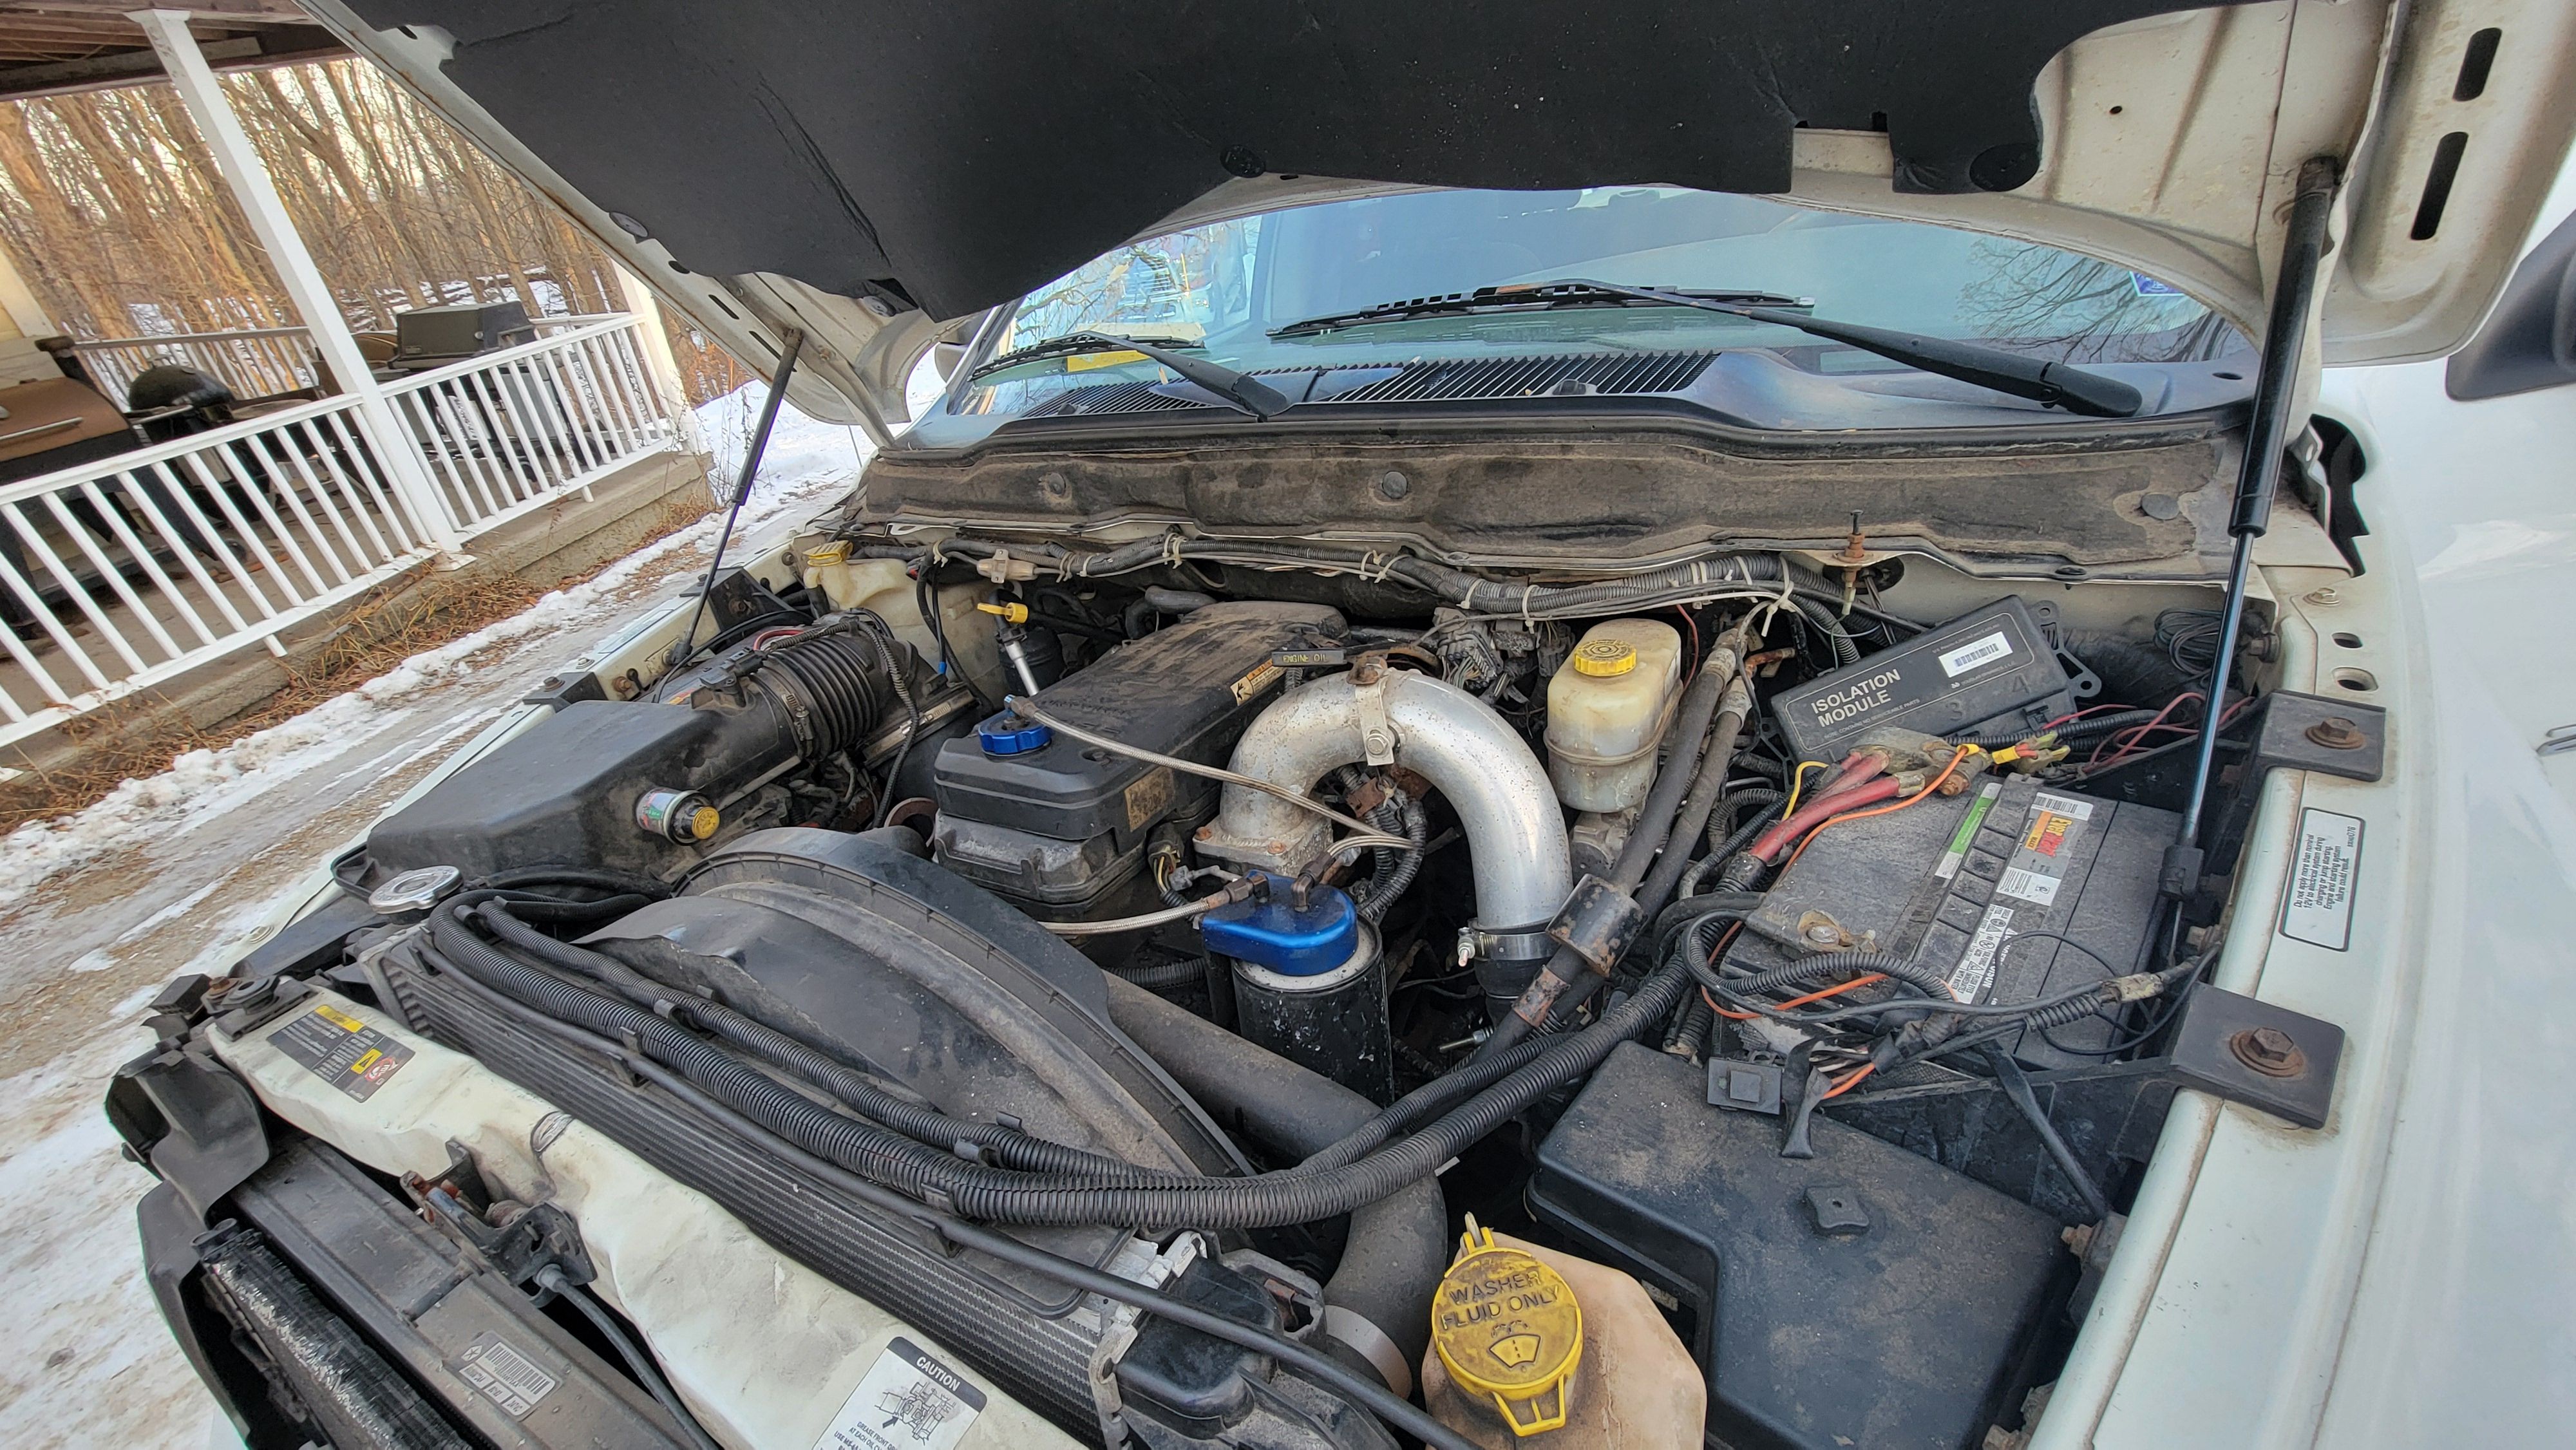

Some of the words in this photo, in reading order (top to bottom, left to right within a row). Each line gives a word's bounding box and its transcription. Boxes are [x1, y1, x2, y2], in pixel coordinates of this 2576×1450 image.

[1283, 655, 1309, 663] ENGINE
[1811, 669, 1902, 714] ISOLATION
[1818, 690, 1891, 728] MODULE
[1903, 698, 1920, 708] PARTS
[2027, 836, 2038, 848] MAXX
[2315, 837, 2325, 851] during
[2313, 852, 2322, 868] system
[2299, 878, 2307, 890] apply
[2309, 869, 2318, 890] electrical
[2324, 893, 2335, 909] Engine
[2331, 863, 2340, 881] starting
[2304, 898, 2313, 908] 12V
[2316, 885, 2326, 905] charging
[2336, 887, 2345, 901] failure
[1449, 1271, 1540, 1306] WASHER
[1440, 1301, 1501, 1330] FLUID
[1508, 1285, 1559, 1311] ONLY
[916, 1356, 960, 1391] CAUTION
[834, 1431, 845, 1442] USE
[854, 1431, 867, 1442] EACH
[865, 1439, 875, 1449] OIL
[856, 1420, 875, 1436] GREASE
[872, 1433, 889, 1447] FRONT
